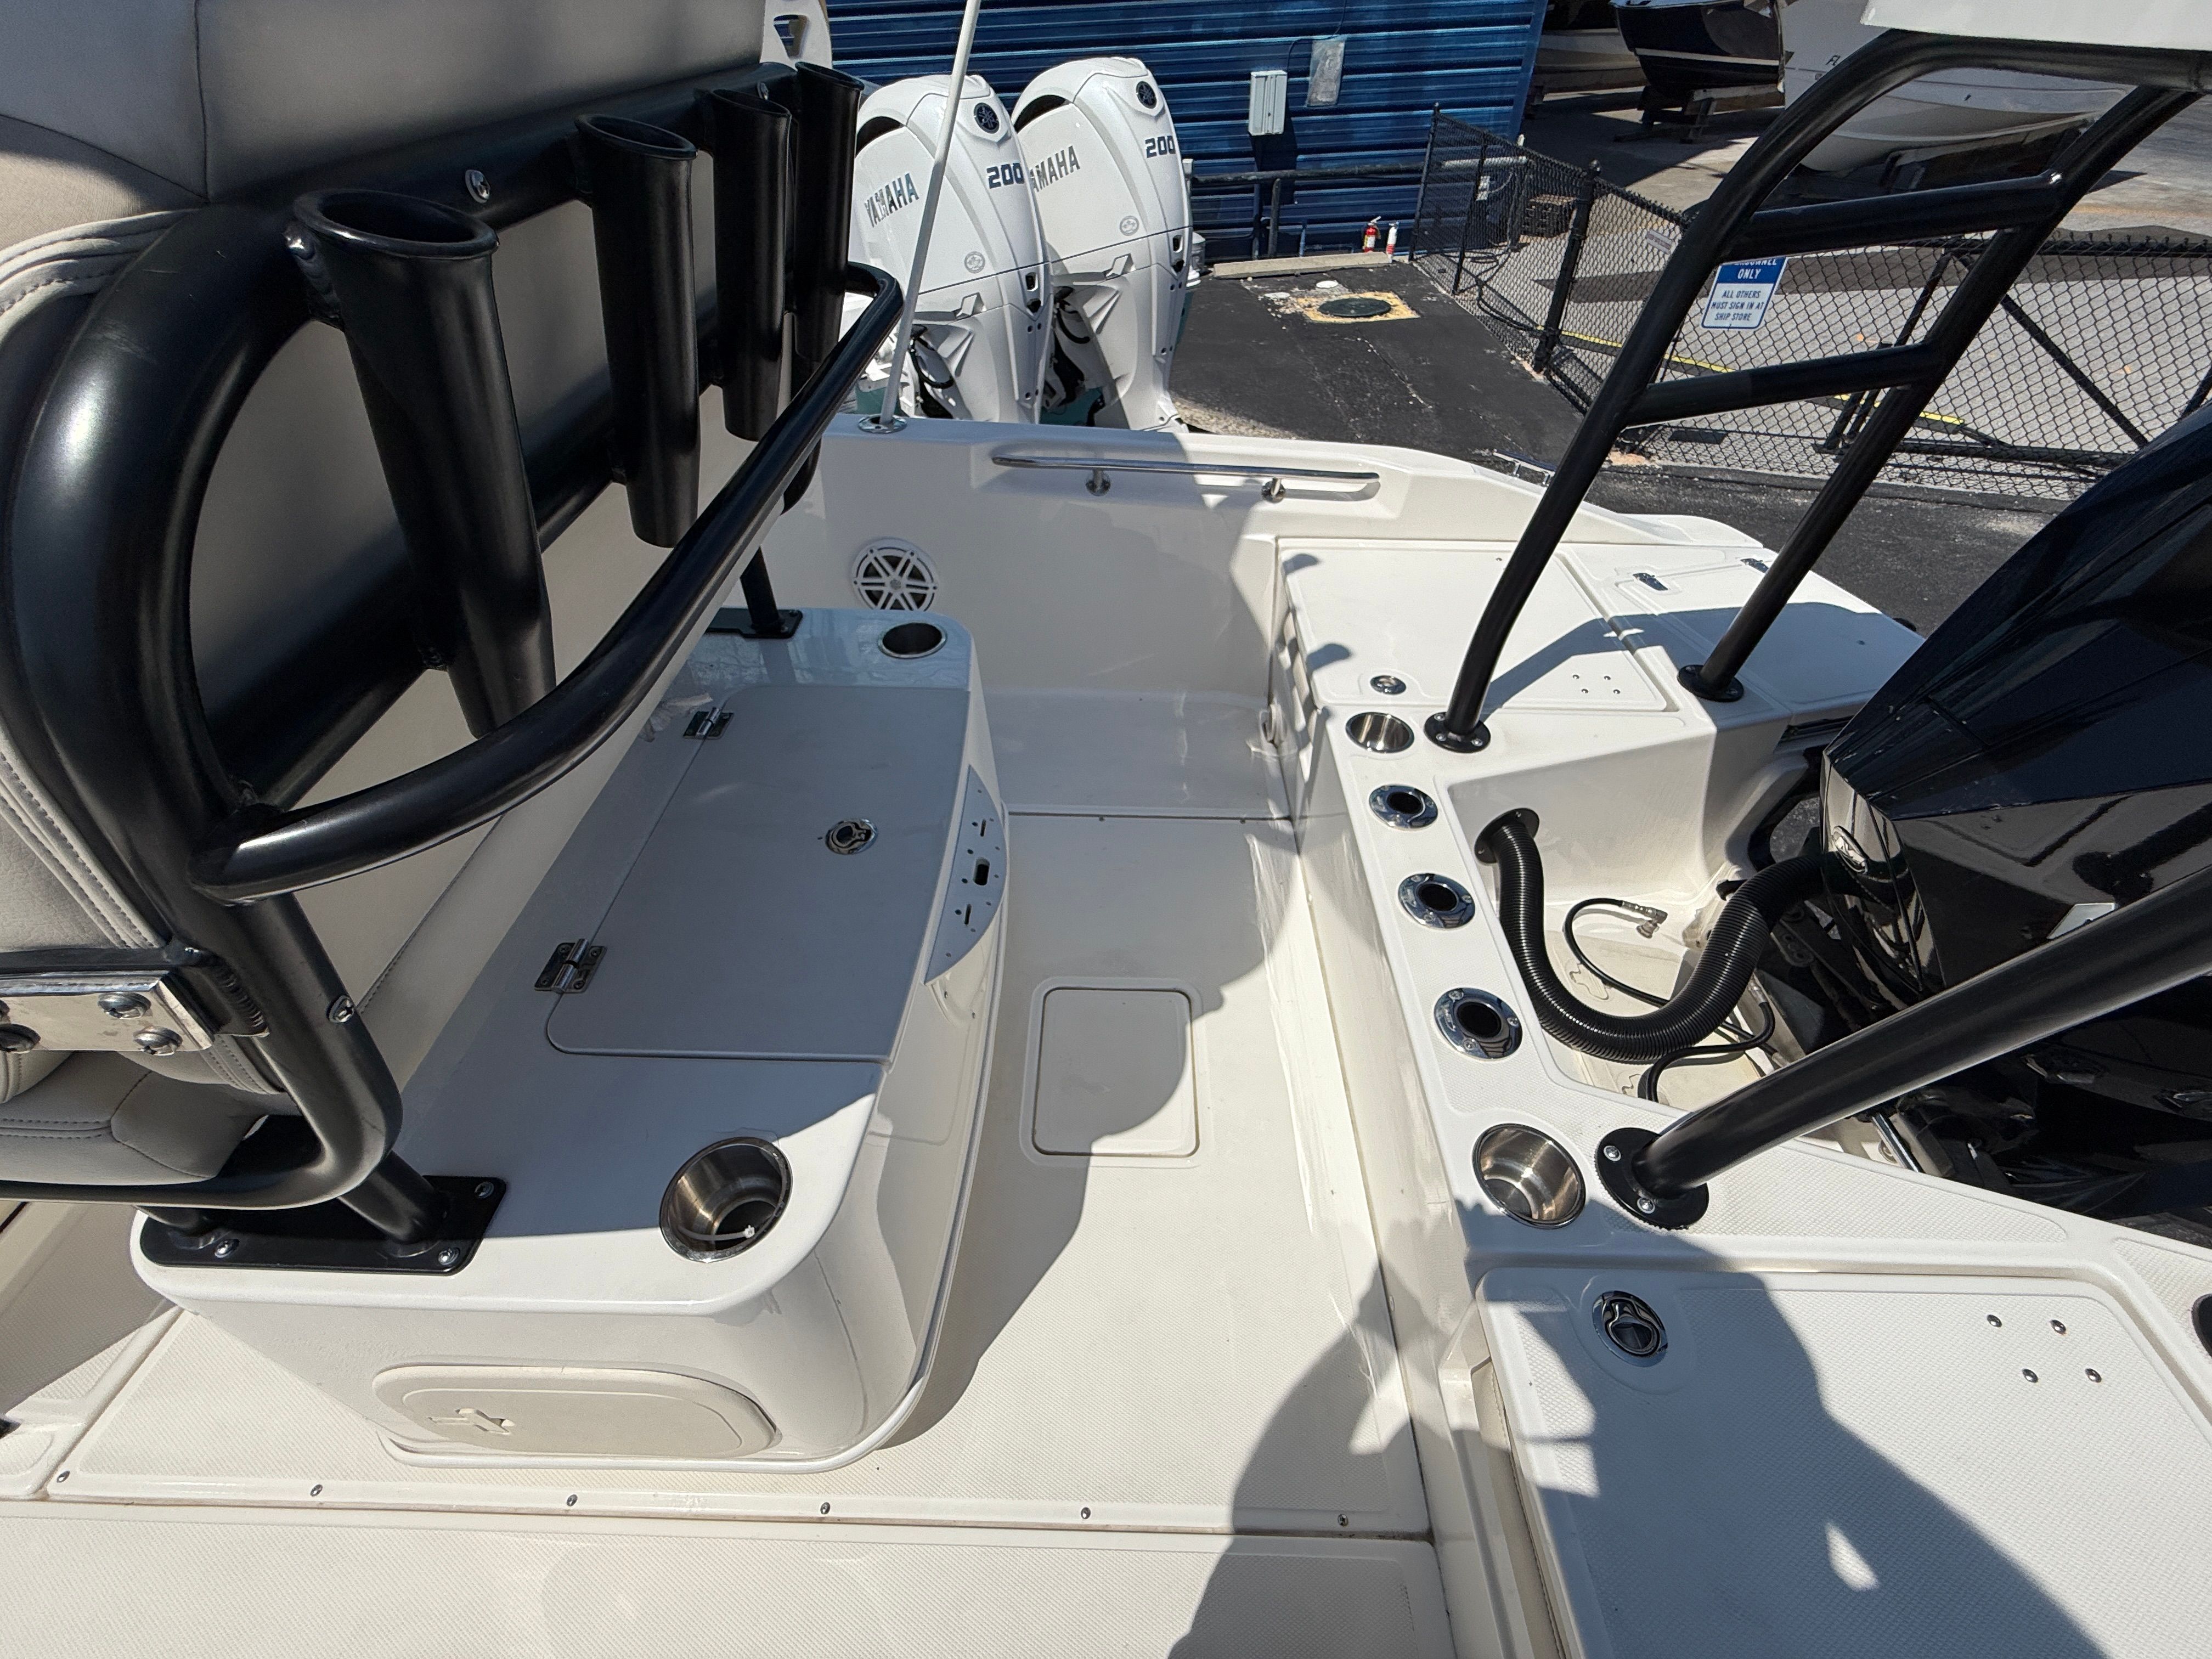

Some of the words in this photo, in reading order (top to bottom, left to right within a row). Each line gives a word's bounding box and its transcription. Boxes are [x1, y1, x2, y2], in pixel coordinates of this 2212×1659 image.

[1145, 135, 1176, 159] 200
[986, 162, 1024, 189] 200
[1029, 145, 1080, 192] AMAHA
[864, 173, 919, 228] YAMAHA
[1737, 268, 1761, 279] ONLY
[1722, 290, 1734, 298] ALL
[1736, 290, 1761, 298] OTHERS
[1714, 313, 1731, 321] SHIP
[1731, 313, 1752, 321] STORE
